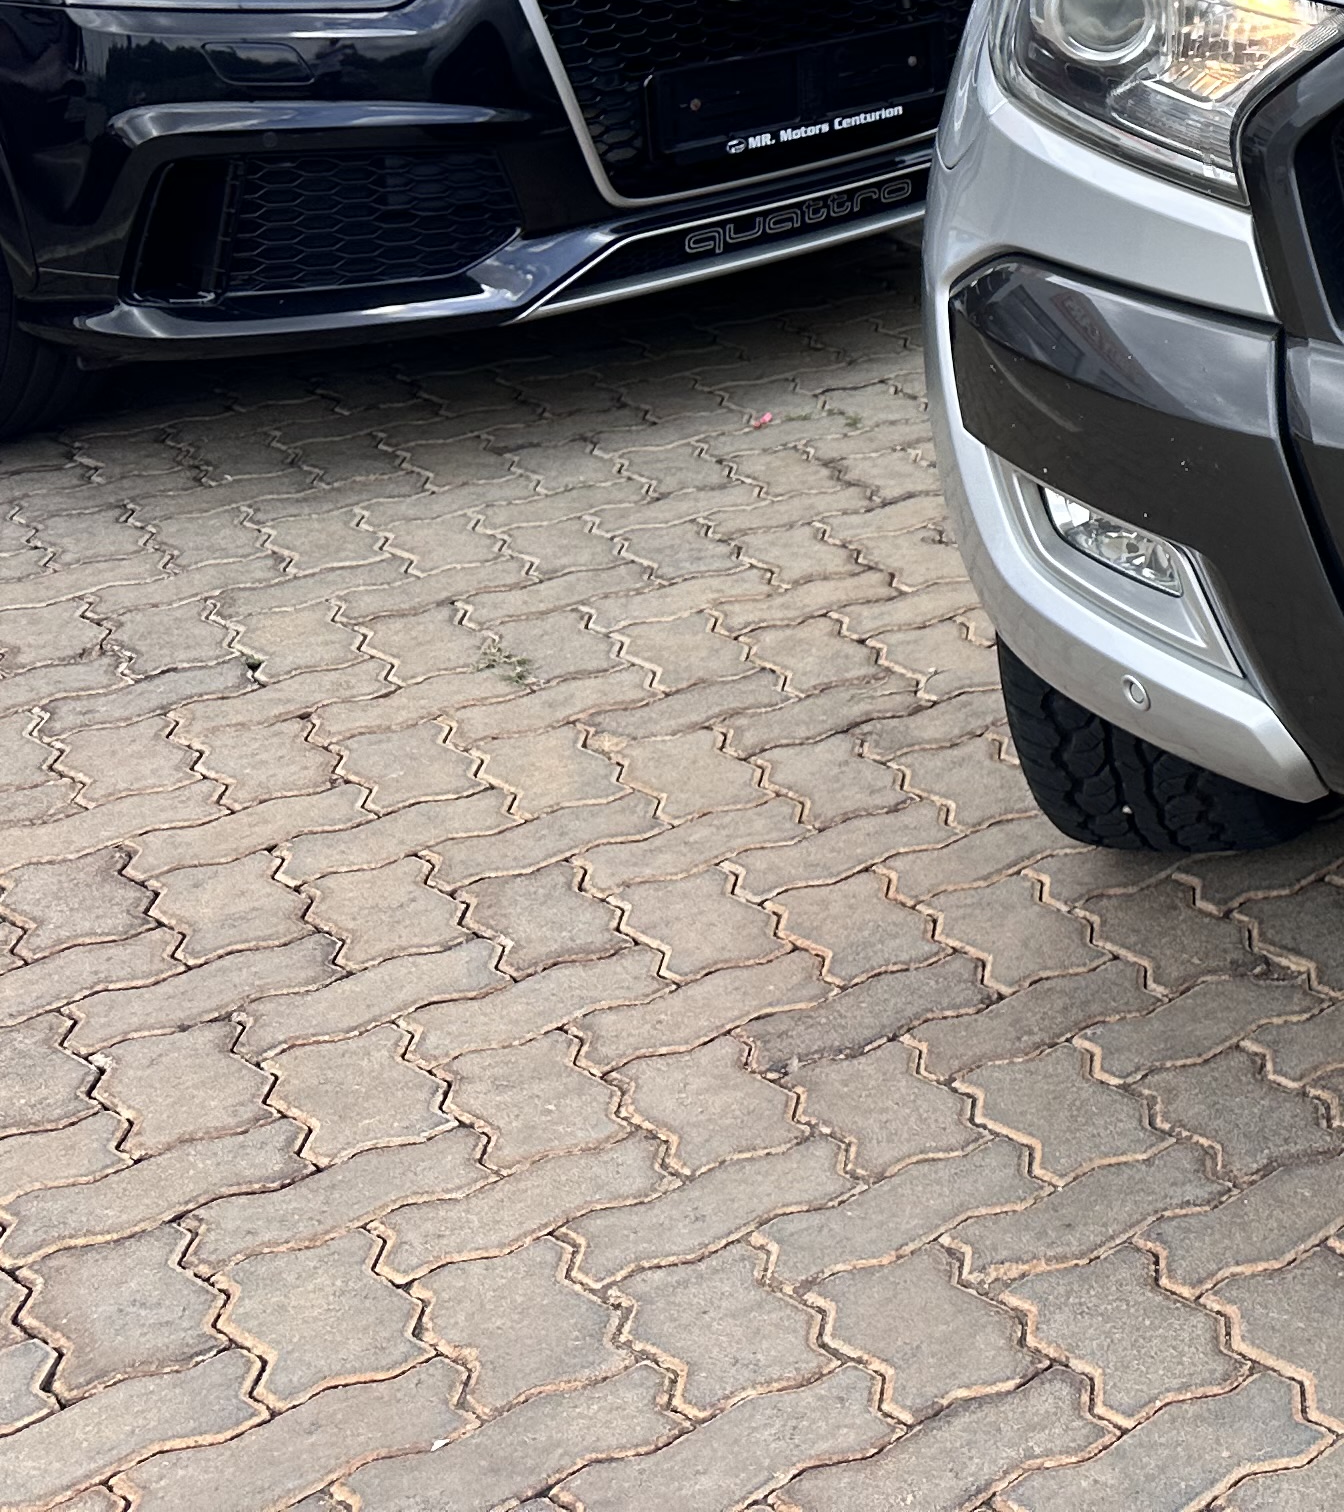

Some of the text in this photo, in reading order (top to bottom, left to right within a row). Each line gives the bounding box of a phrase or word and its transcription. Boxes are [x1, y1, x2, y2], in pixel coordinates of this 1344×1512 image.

[748, 105, 903, 149] MR. Motors Centurion
[685, 179, 912, 254] quattro
